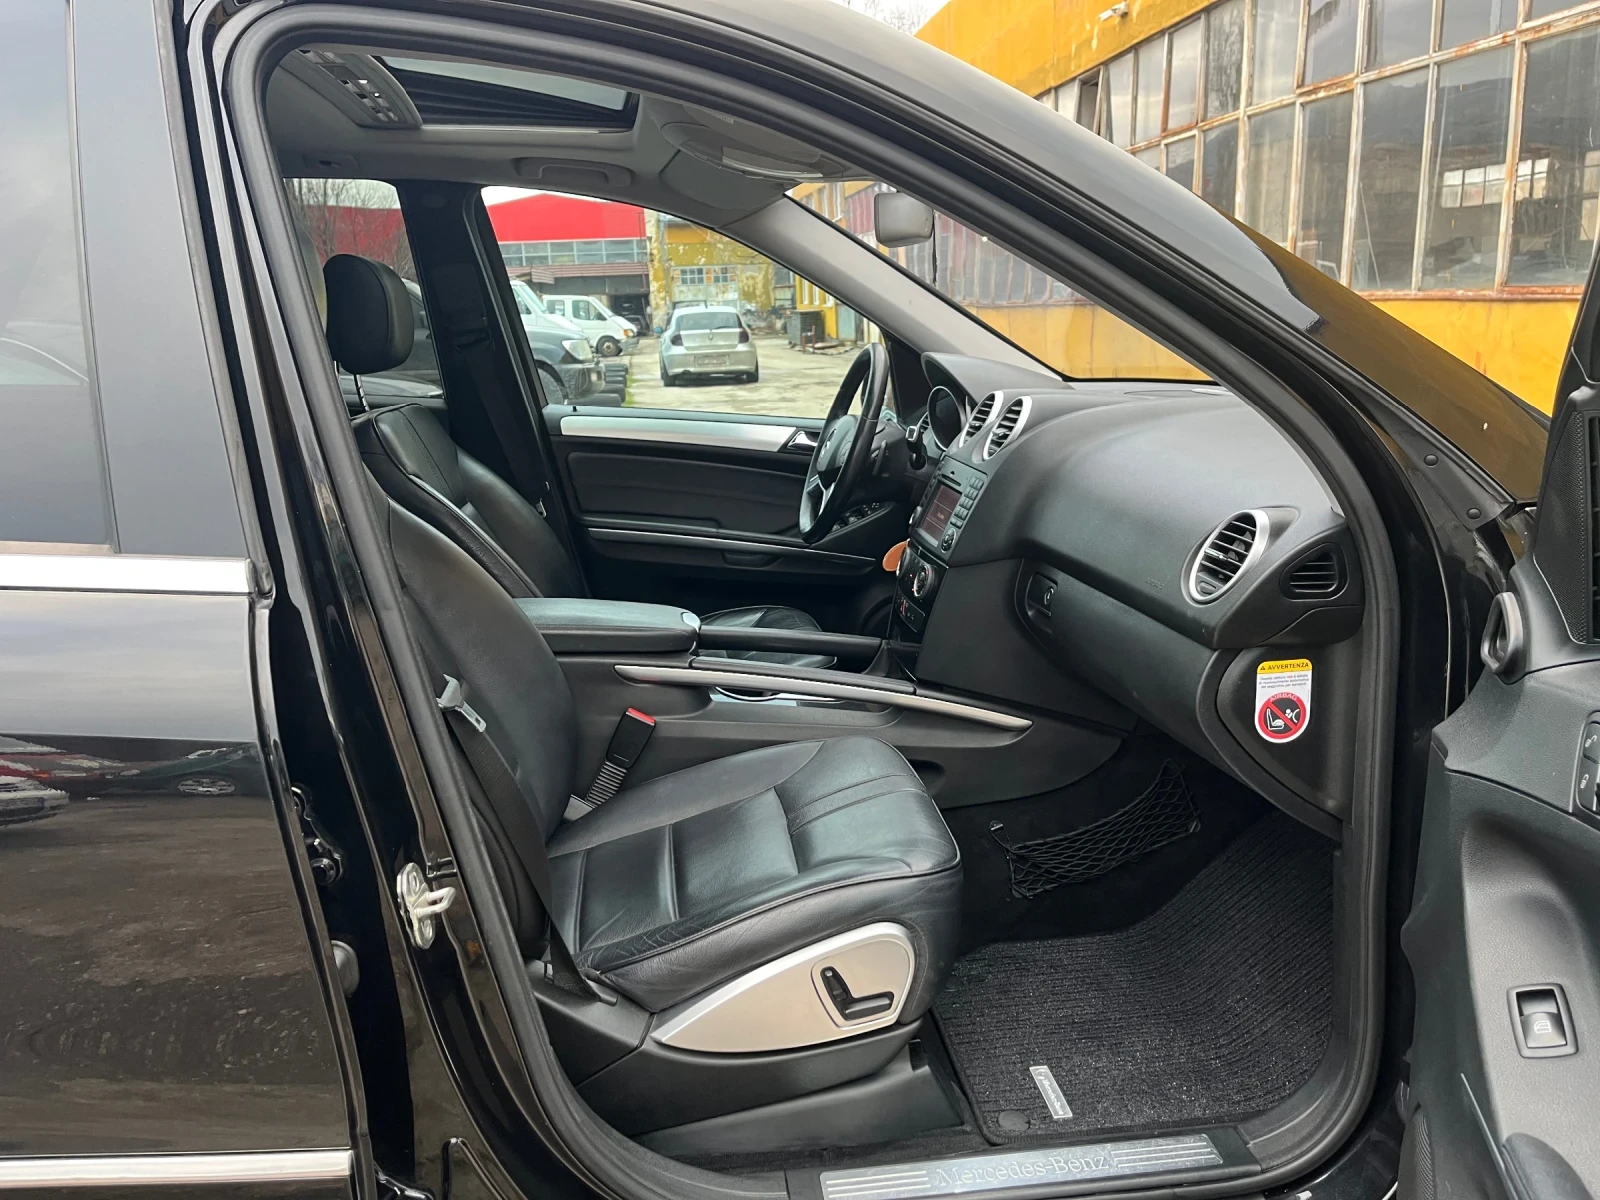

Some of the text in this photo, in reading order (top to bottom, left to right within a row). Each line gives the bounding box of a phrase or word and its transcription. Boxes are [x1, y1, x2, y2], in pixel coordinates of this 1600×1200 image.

[1268, 662, 1309, 670] AVVERTENZA
[1270, 692, 1298, 703] AIRBAG
[936, 1156, 1110, 1187] Mercedes-Benz
